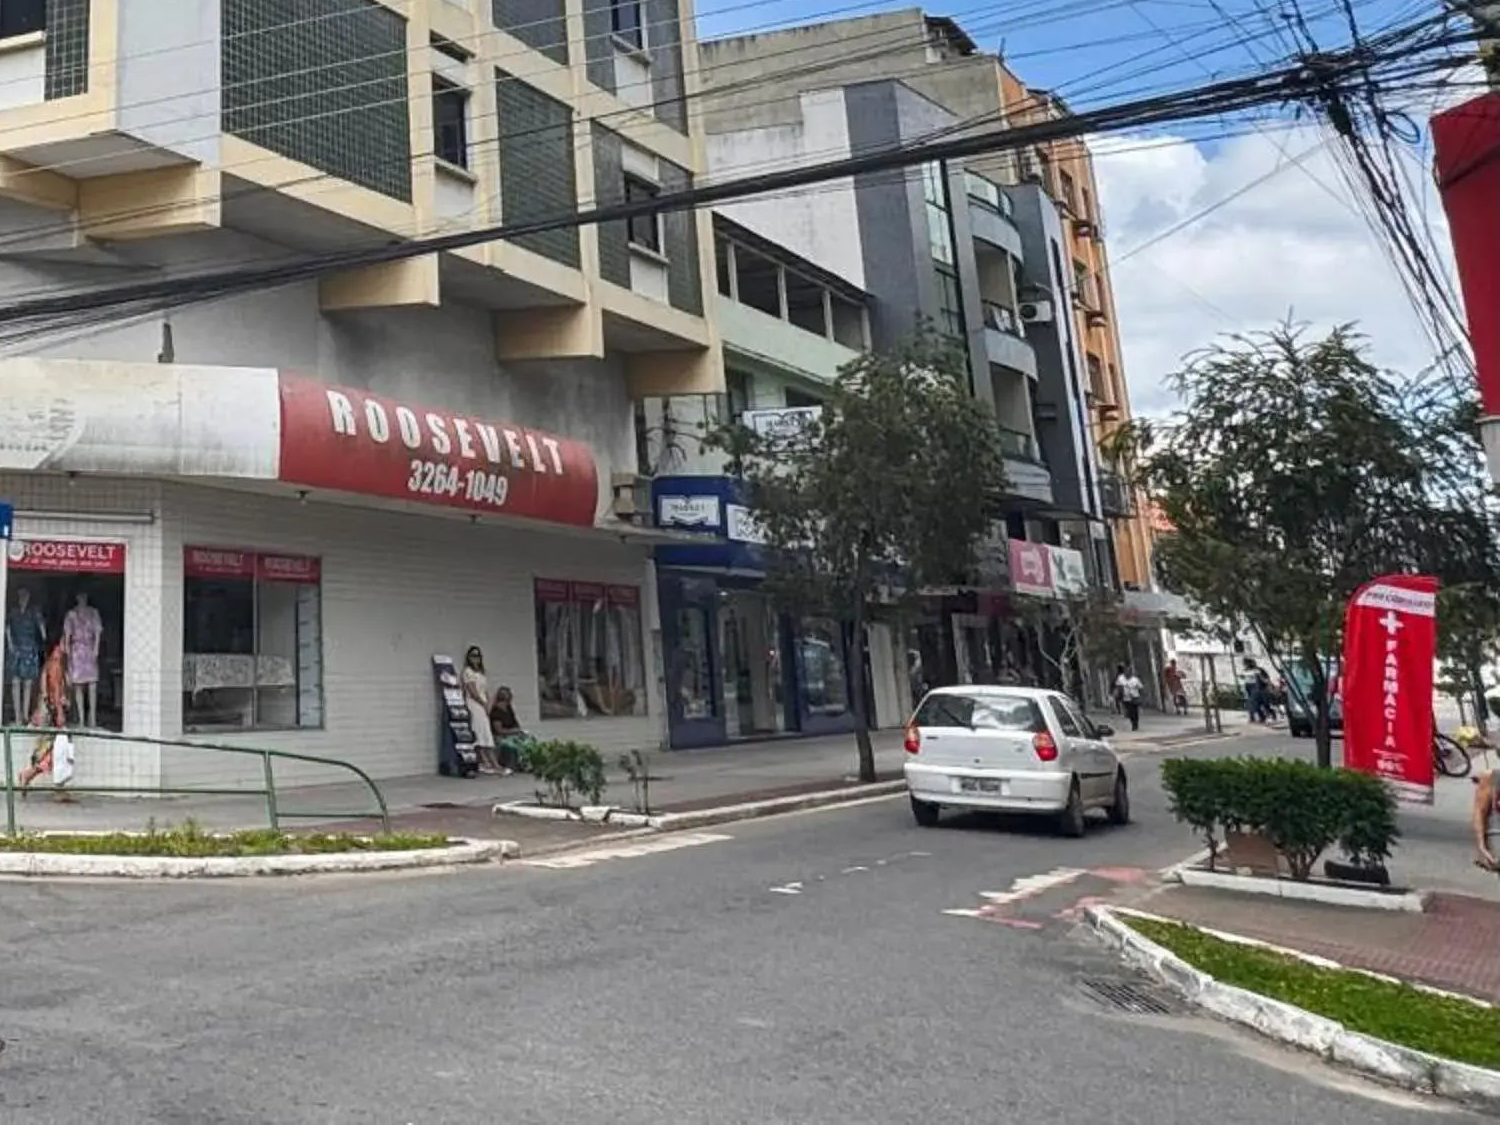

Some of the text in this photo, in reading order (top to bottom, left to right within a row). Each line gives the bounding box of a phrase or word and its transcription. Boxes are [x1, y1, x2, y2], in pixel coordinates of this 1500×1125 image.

[326, 390, 563, 475] ROOSEVELT
[408, 459, 509, 506] 3264-1049
[24, 542, 117, 560] ROOSEVELT
[1383, 640, 1399, 748] FARMACIA
